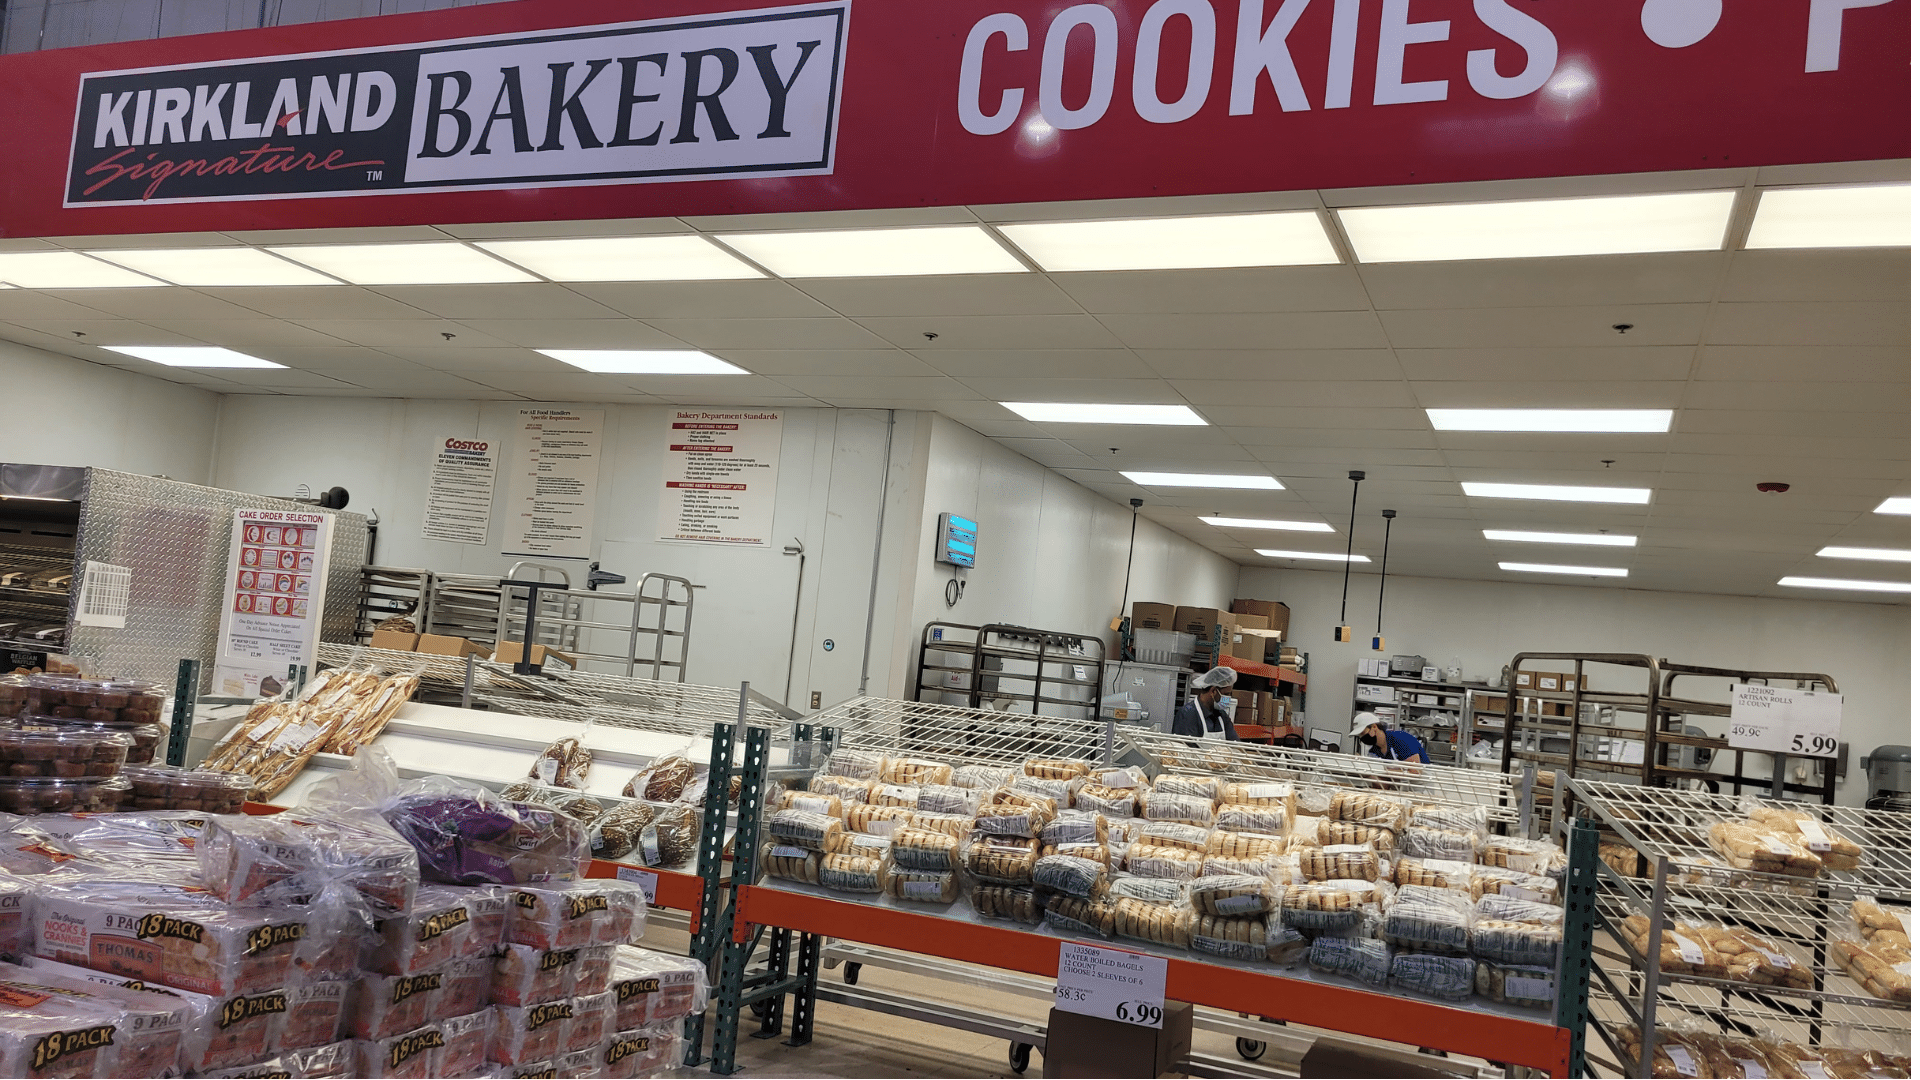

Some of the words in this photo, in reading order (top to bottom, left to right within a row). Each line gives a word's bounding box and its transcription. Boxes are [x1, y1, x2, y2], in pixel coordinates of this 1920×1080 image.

[958, 0, 1559, 135] COOKIES
[418, 41, 821, 158] BAKERY
[94, 70, 396, 148] KIRKLAND
[84, 143, 385, 202] Signature
[676, 412, 699, 420] Bakery
[701, 412, 742, 420] Department
[445, 438, 488, 451] COSTCO
[239, 511, 257, 519] CAKE
[259, 512, 283, 520] ORDER
[286, 513, 324, 523] SELECTION
[10, 653, 38, 661] BELGIAN
[1738, 693, 1768, 702] ARTISAN
[1770, 696, 1793, 704] ROLLS
[1747, 687, 1775, 696] 1221092
[1746, 700, 1771, 708] COUNT
[1791, 734, 1837, 755] 5.99
[275, 847, 308, 861] PAC
[516, 893, 535, 906] CK
[44, 920, 78, 935] NOOKS
[80, 926, 87, 936] &
[105, 915, 113, 927] 9
[138, 914, 161, 936] 18
[164, 920, 202, 940] PACK
[421, 916, 441, 940] 18
[440, 908, 467, 928] PACK
[43, 930, 87, 947] CRANNIES
[247, 926, 272, 953] 18
[274, 923, 307, 942] PACK
[96, 942, 154, 963] THOMAS
[1073, 946, 1100, 956] 1335089
[1065, 953, 1089, 962] WATER
[1090, 957, 1115, 967] BOILED
[1116, 961, 1144, 972] BAGELS
[1072, 961, 1096, 970] COUNT
[166, 974, 213, 991] ORIGINAL
[665, 974, 671, 983] 9
[1063, 966, 1091, 976] CHOOSE
[1097, 972, 1127, 983] SLEEVES
[312, 985, 340, 997] PACK
[395, 977, 412, 1001] 18
[413, 977, 440, 991] PACK
[632, 979, 659, 994] PACK
[222, 998, 245, 1027] 18
[248, 997, 285, 1014] PACK
[530, 1006, 545, 1028] 18
[547, 1005, 573, 1020] PACK
[1116, 1001, 1162, 1025] 6.99
[133, 1017, 144, 1029] 9
[149, 1014, 183, 1028] PACK
[34, 1033, 62, 1068] 18
[65, 1027, 113, 1052] PACK
[392, 1038, 410, 1067] 18
[411, 1032, 443, 1052] PACK
[608, 1042, 625, 1063] 18
[626, 1038, 648, 1054] PACK
